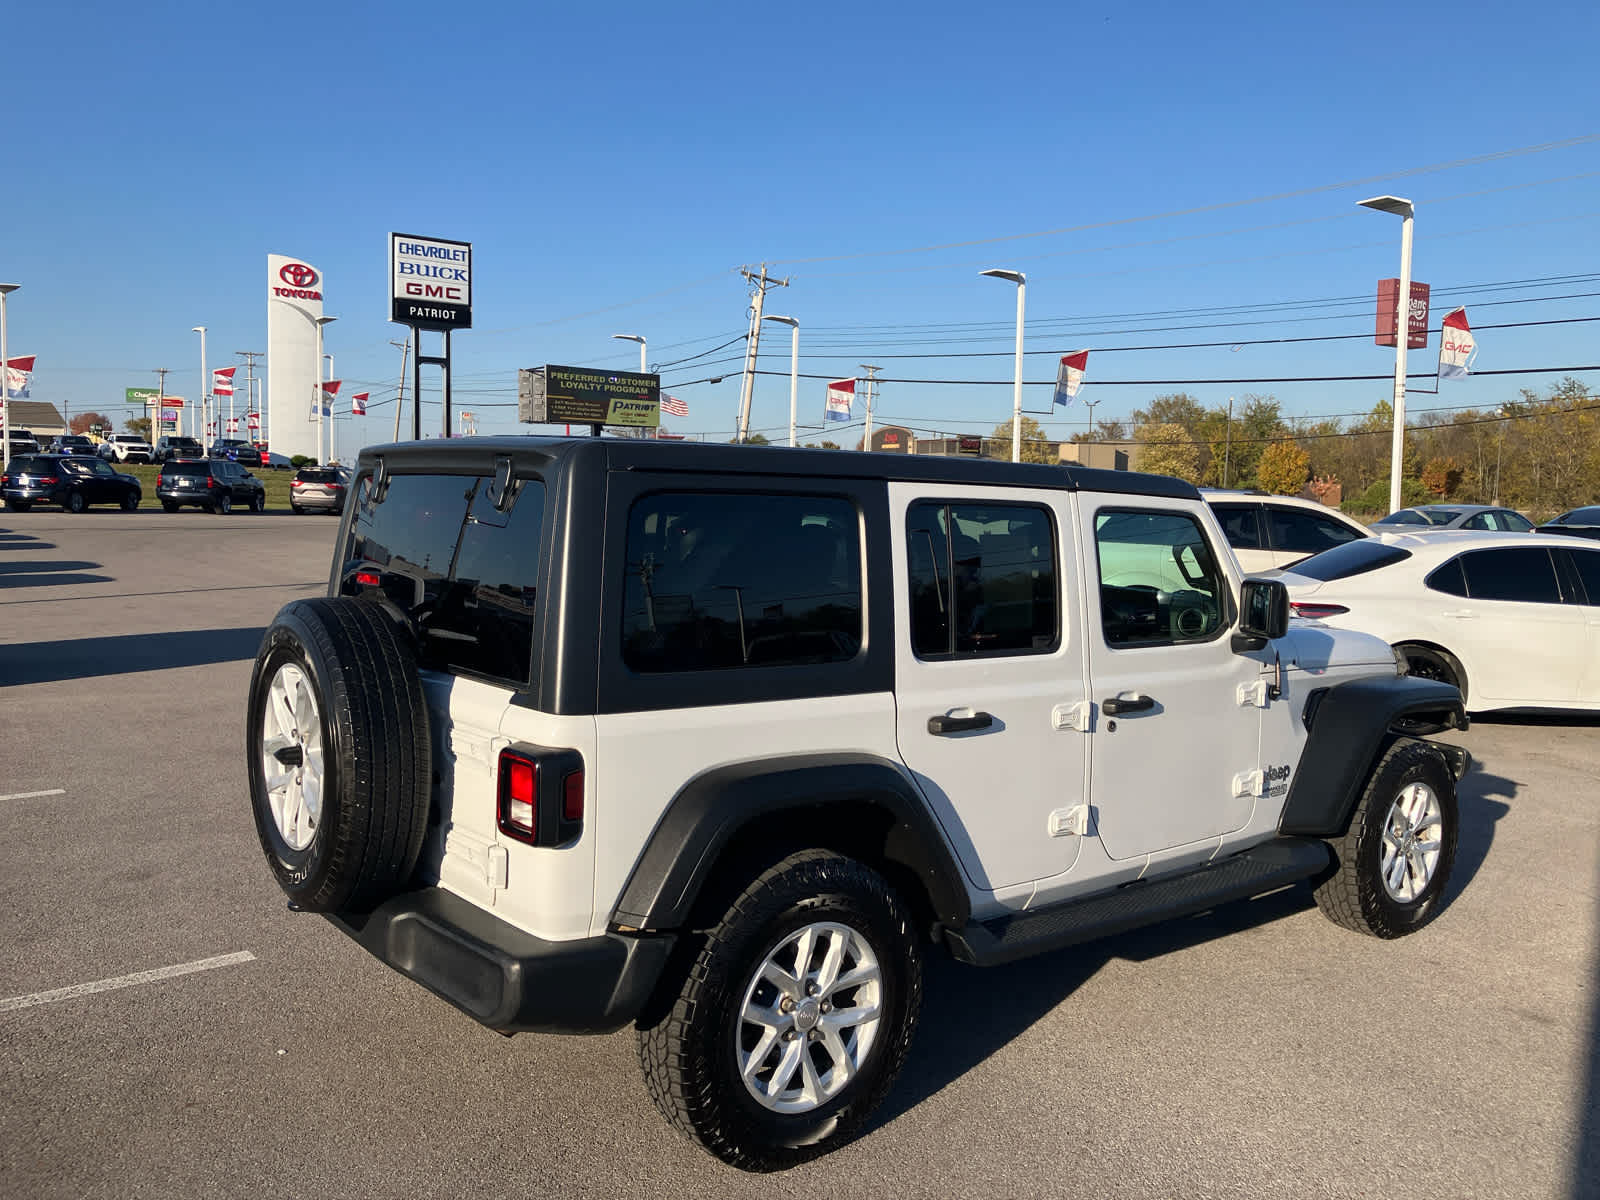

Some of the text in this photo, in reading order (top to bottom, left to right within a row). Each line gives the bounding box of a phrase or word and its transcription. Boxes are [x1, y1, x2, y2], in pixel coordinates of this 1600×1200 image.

[399, 242, 468, 262] CHEVROLET
[399, 261, 468, 282] BUICK
[272, 287, 323, 301] TOYOTA
[406, 282, 462, 300] GMC
[409, 306, 457, 320] PATRIOT
[551, 371, 657, 388] PREFERRED CUSTOMER
[560, 380, 648, 395] LOYALTY PROGRAM
[613, 400, 656, 413] PATRIOT
